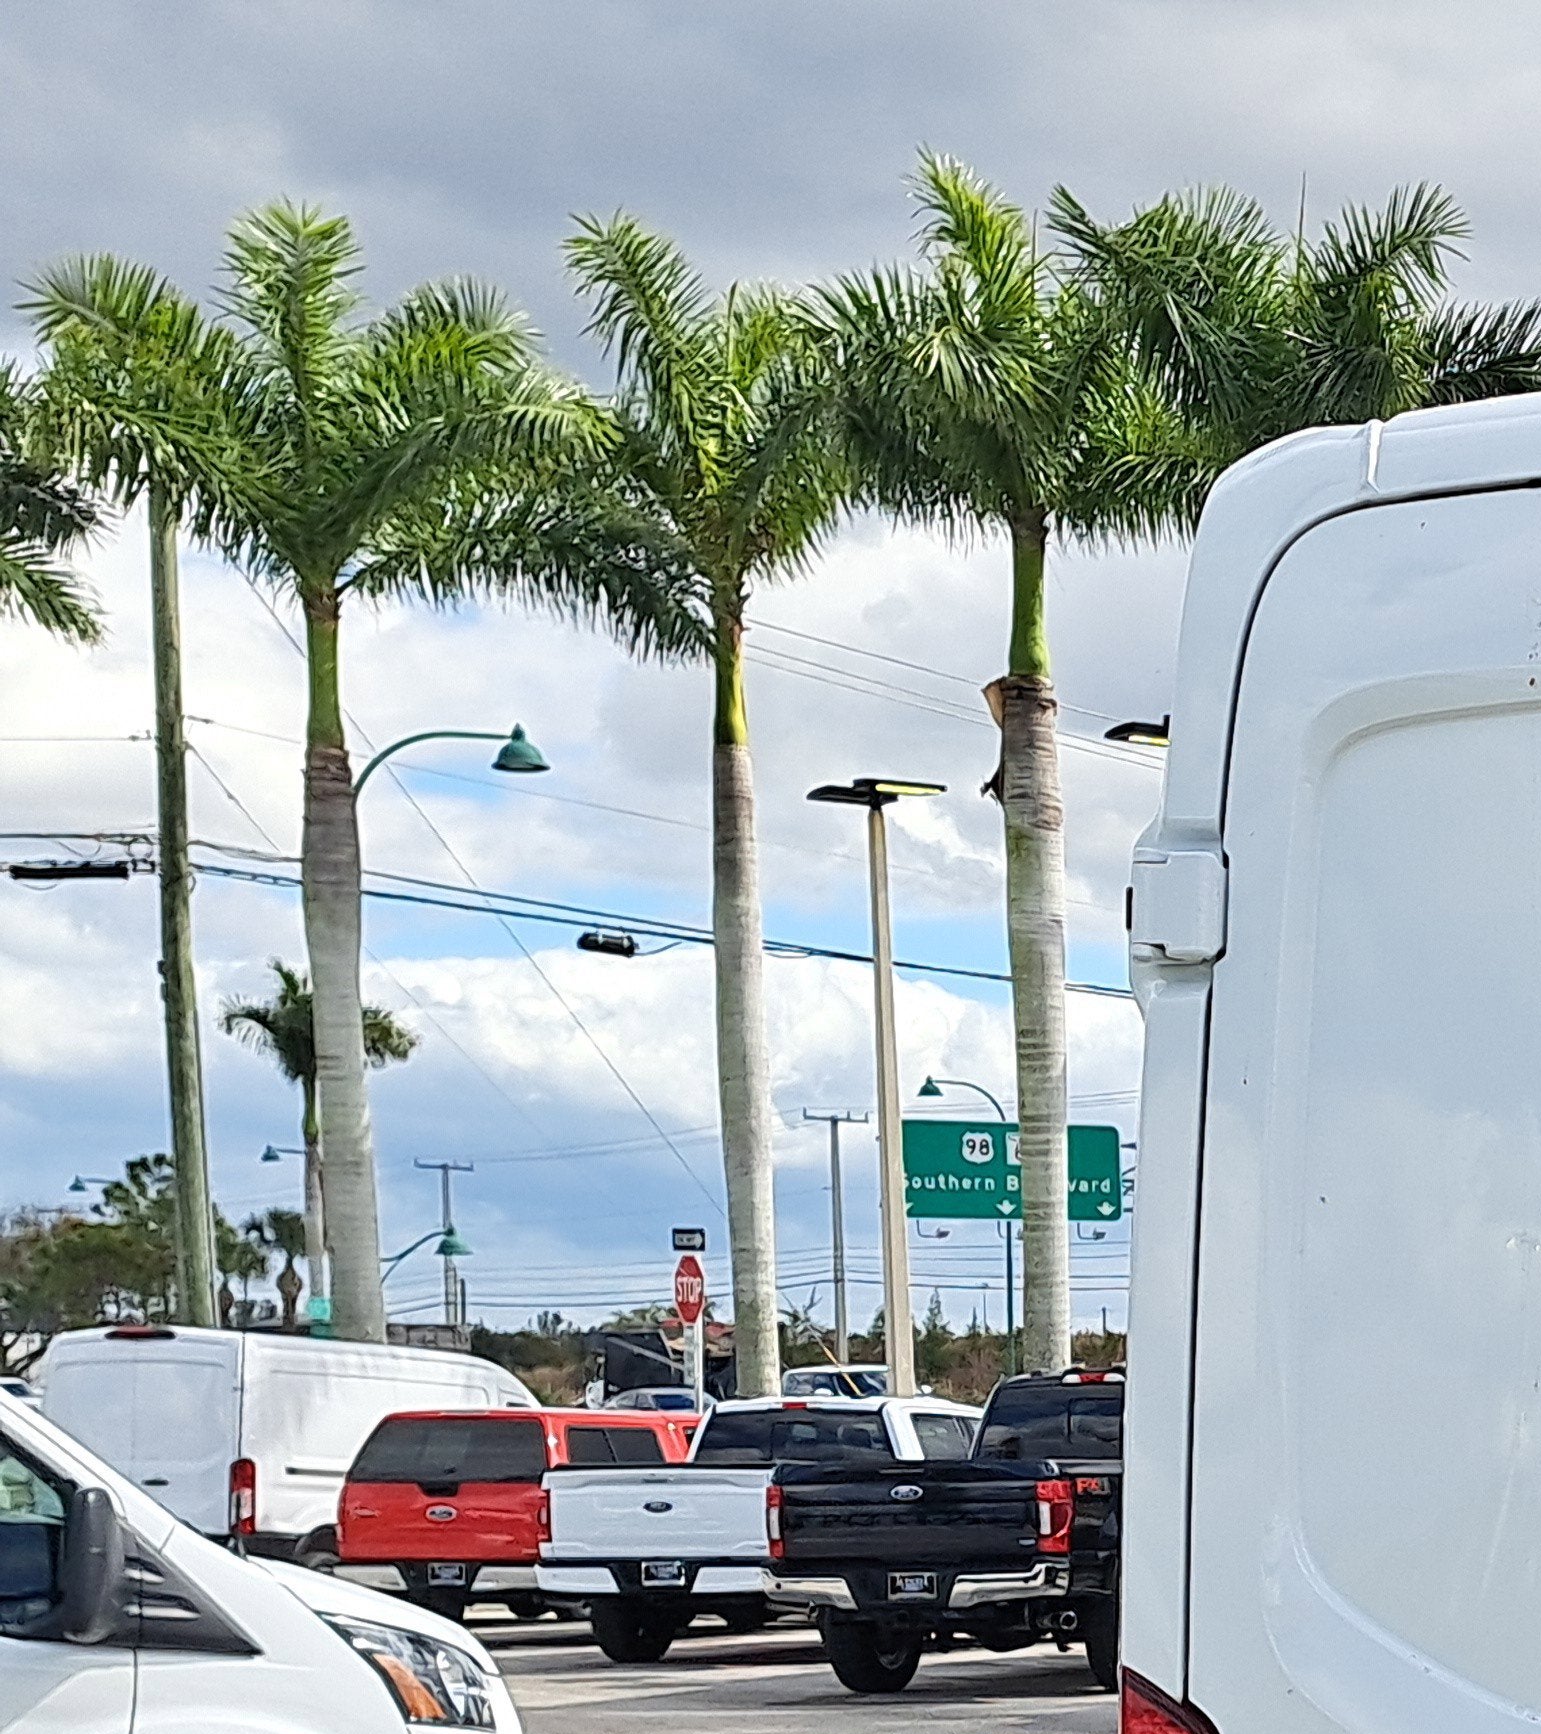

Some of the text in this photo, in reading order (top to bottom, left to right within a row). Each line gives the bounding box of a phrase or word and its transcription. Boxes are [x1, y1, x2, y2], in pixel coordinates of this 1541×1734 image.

[965, 1138, 990, 1156] 98
[1006, 1174, 1111, 1193] Bvard
[676, 1276, 702, 1304] STOP
